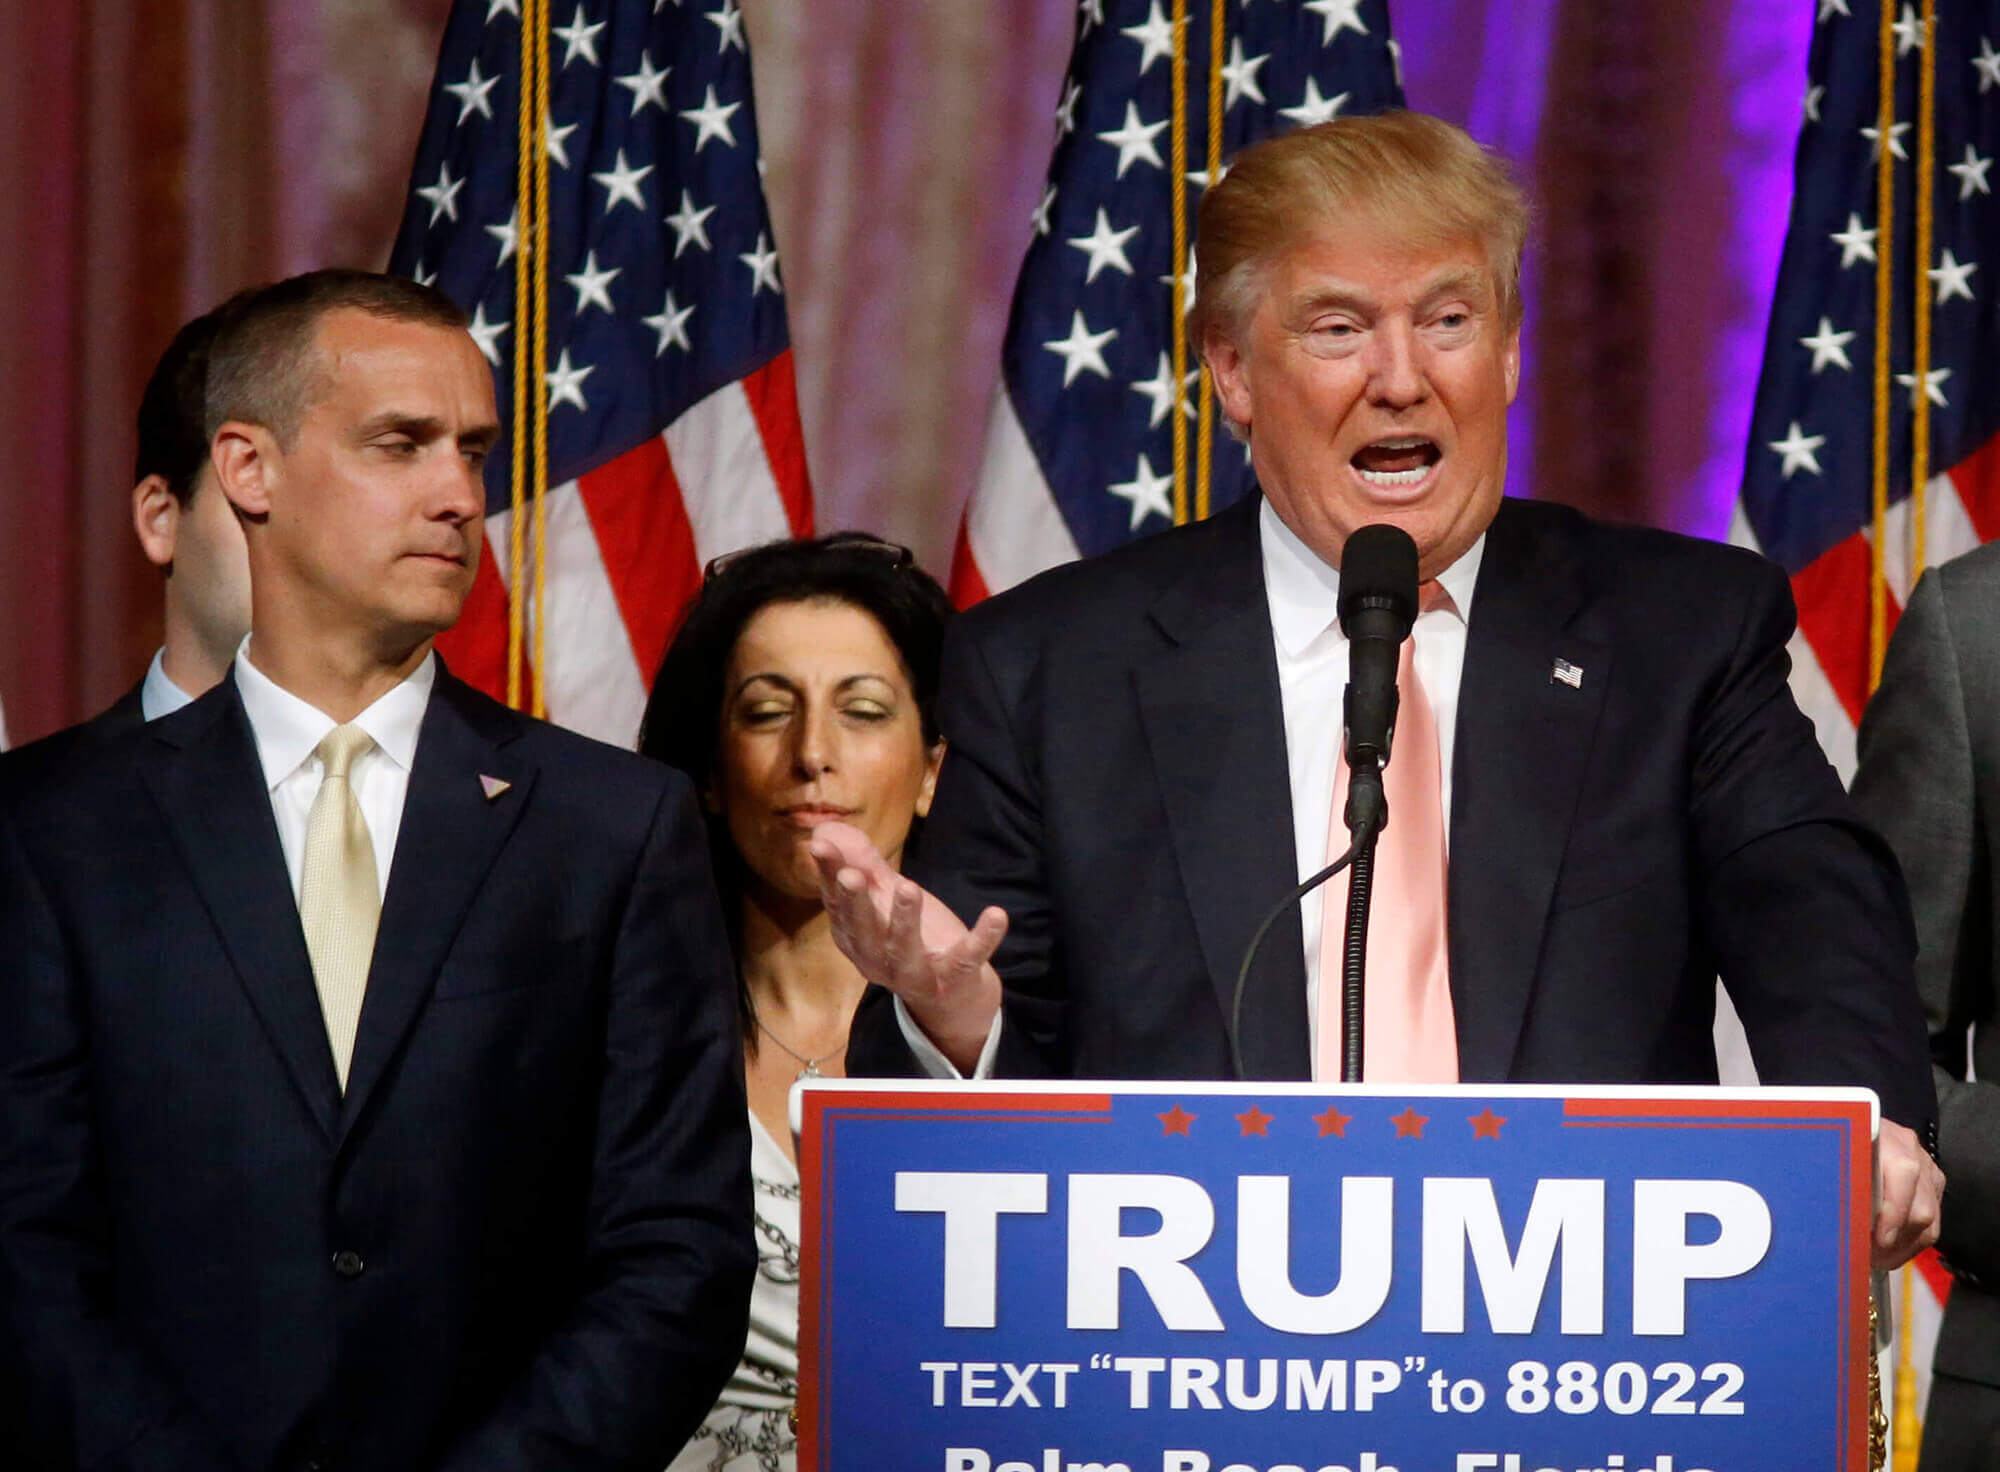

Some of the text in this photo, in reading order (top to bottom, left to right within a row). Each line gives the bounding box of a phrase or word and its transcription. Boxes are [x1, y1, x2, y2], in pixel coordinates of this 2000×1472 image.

[894, 1171, 1773, 1336] TRUMP
[920, 1353, 1745, 1415] TEXT “TRUMP” to 88022
